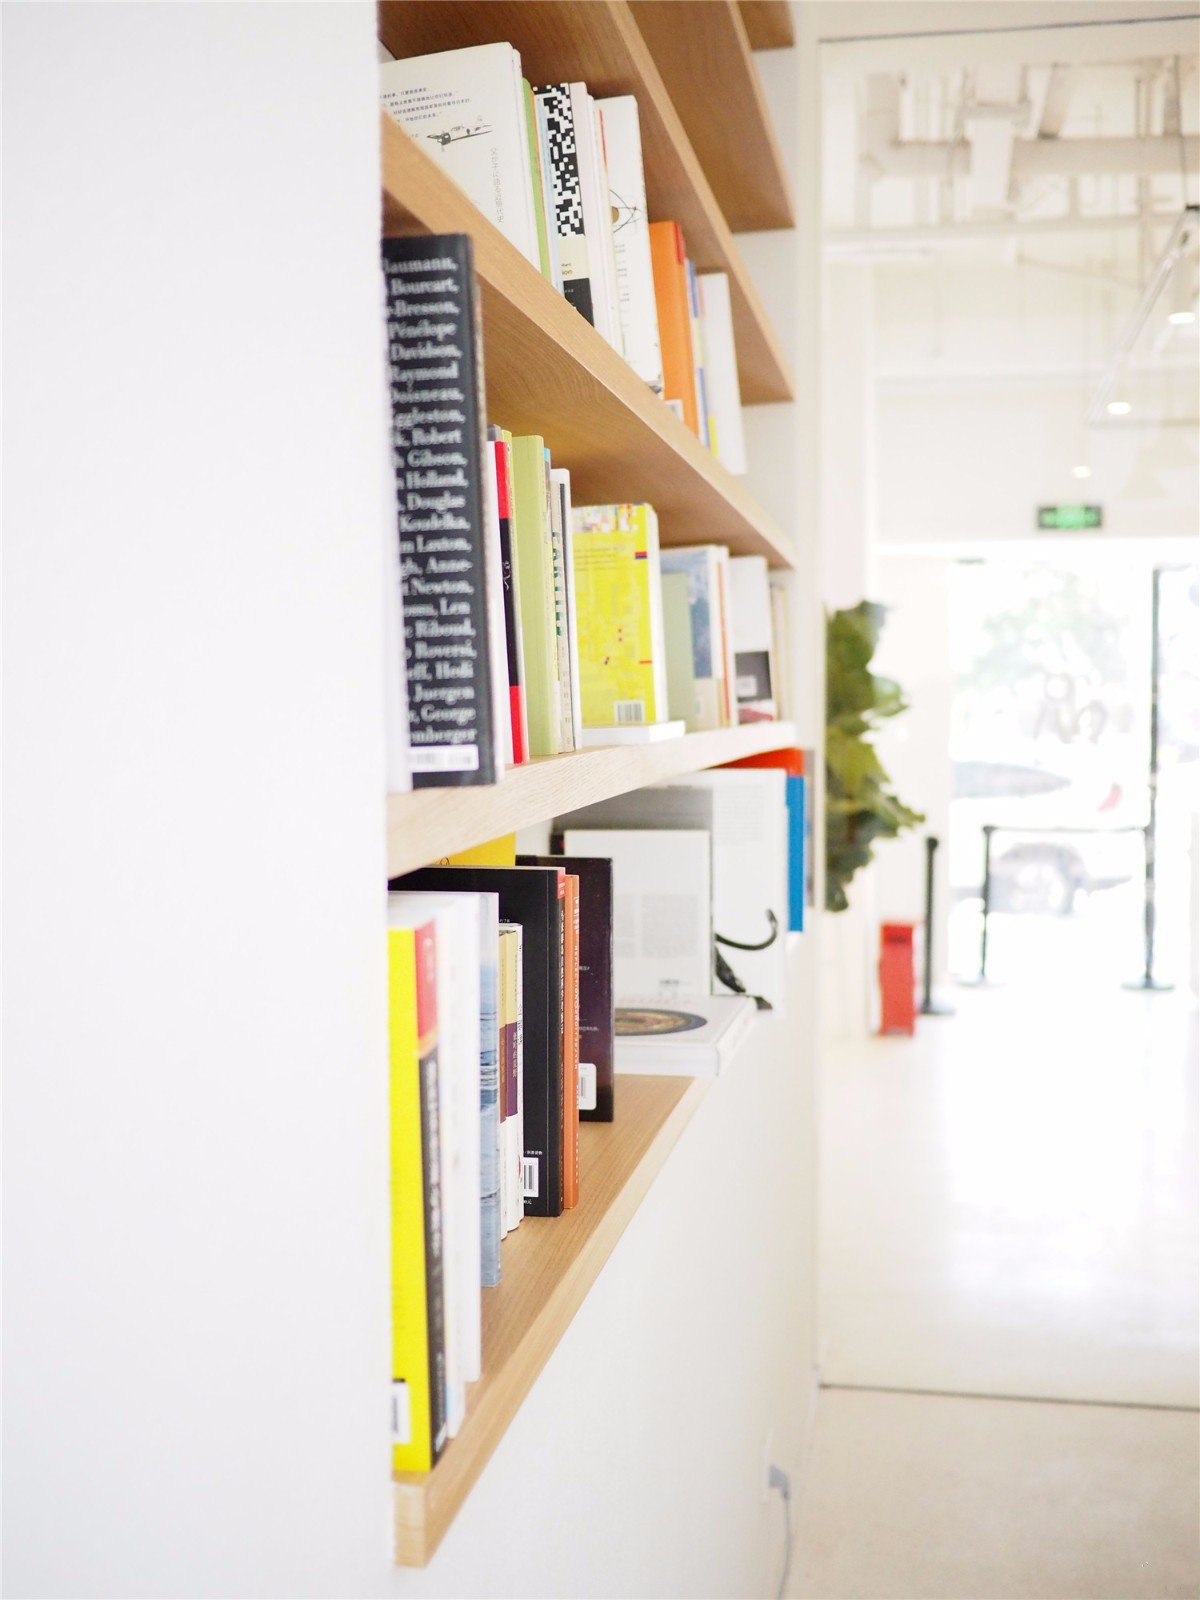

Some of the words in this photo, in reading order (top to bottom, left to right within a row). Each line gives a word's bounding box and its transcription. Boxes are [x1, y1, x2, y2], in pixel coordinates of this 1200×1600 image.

[393, 406, 466, 430] ggleston,
[412, 427, 463, 446] Robert
[407, 449, 468, 467] Gibson,
[406, 468, 469, 489] Holland,
[406, 490, 466, 514] Douglas
[410, 576, 474, 595] Newton,
[415, 639, 477, 659] Roversi,
[413, 683, 475, 705] Juergen
[420, 703, 477, 726] George
